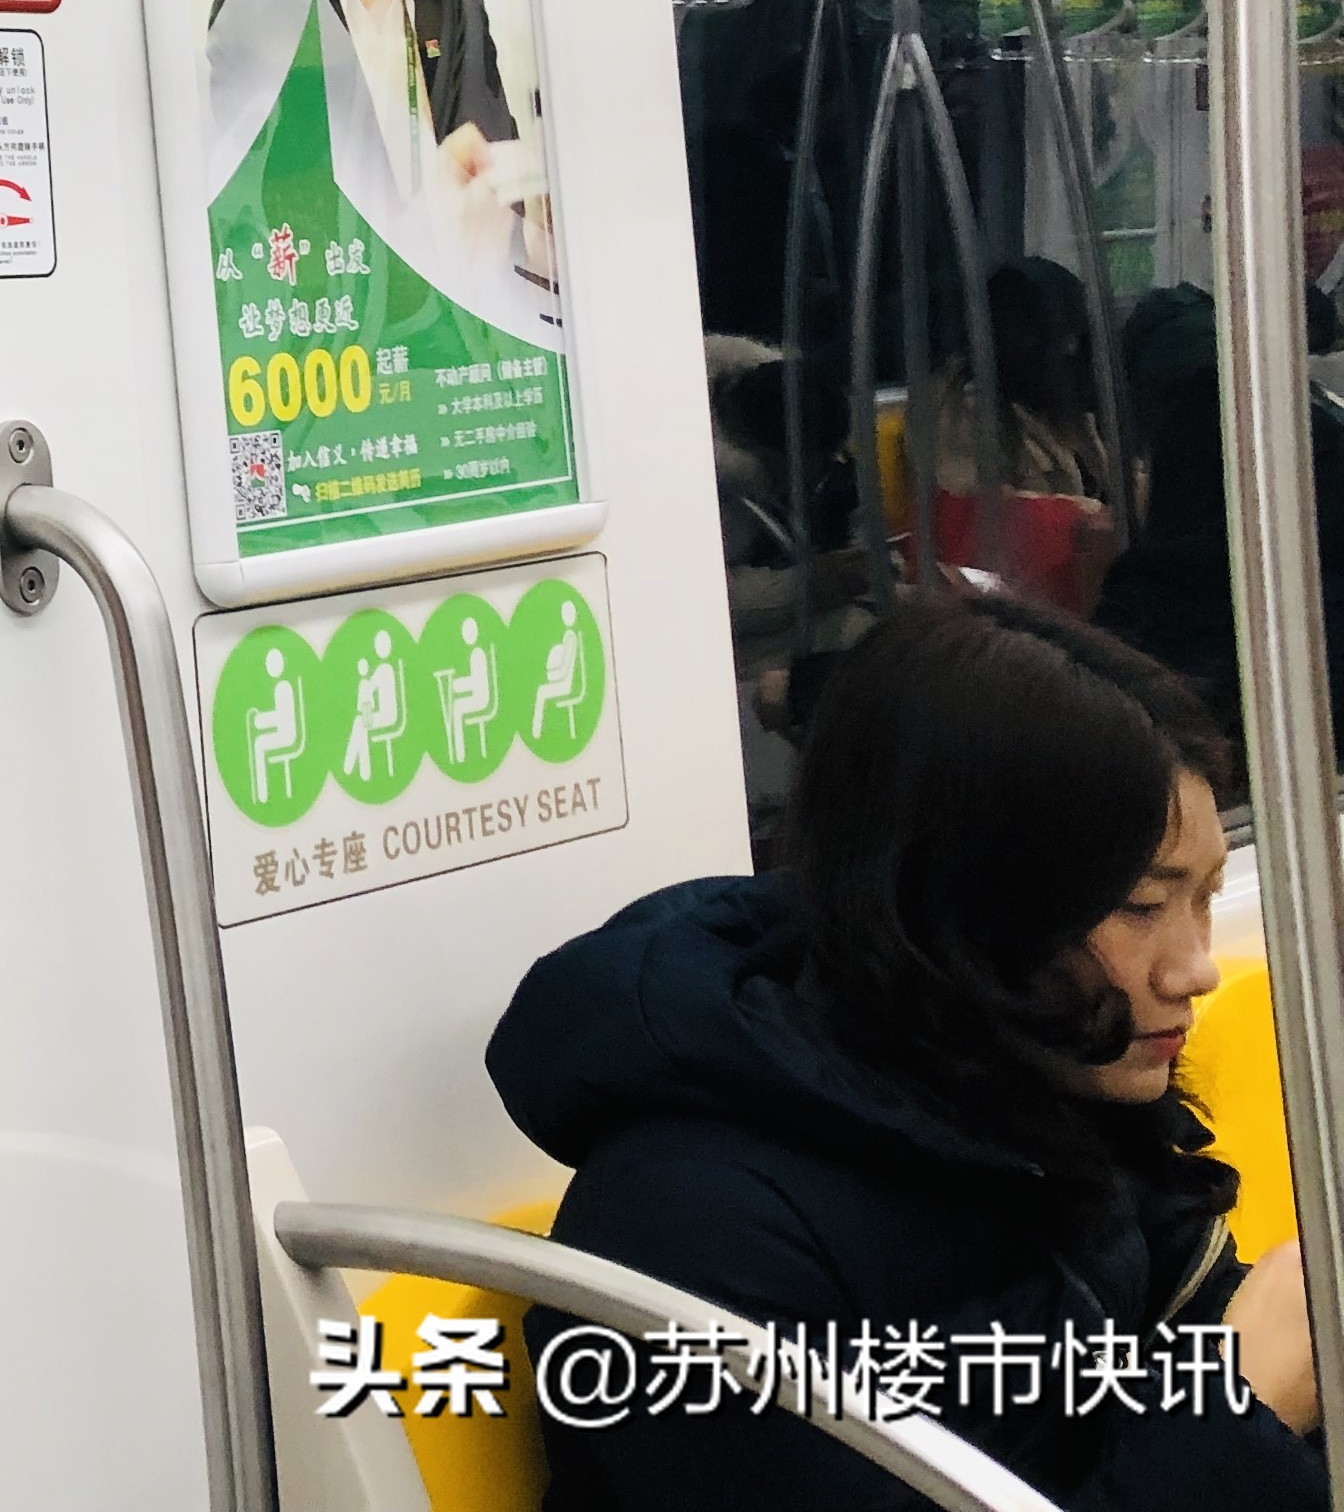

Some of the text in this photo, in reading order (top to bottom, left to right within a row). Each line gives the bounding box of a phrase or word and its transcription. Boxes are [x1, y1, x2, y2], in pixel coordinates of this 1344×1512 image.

[238, 294, 360, 342] 让梦想更近
[228, 344, 372, 427] 6000
[378, 381, 412, 405] 元/月
[252, 777, 602, 896] 爱心专座 COURTESY SEAT
